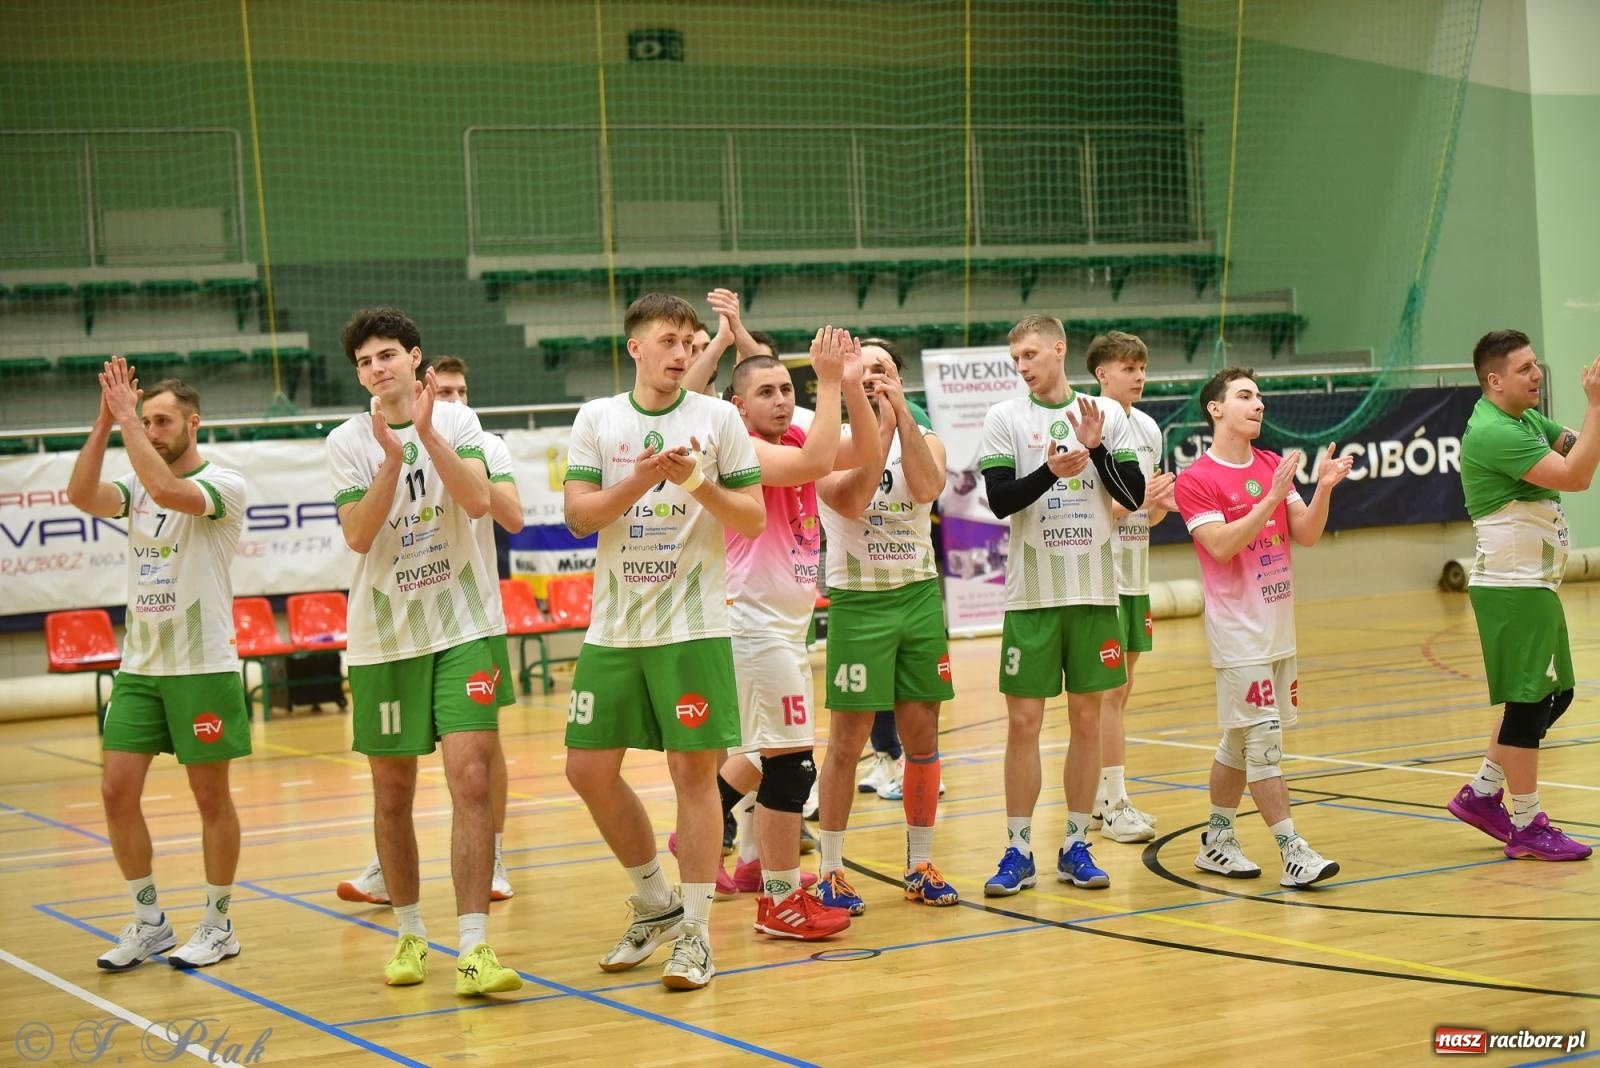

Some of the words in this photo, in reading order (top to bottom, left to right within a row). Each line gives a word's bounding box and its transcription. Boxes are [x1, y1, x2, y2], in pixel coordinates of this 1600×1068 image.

[938, 361, 1017, 381] PIVEXIN
[942, 380, 1018, 394] TECHNOLOGY
[405, 469, 426, 502] 11
[154, 513, 167, 538] 7
[389, 505, 445, 530] VISON
[1043, 527, 1093, 541] PIVEXIN
[1045, 538, 1093, 548] TECHNOLOGY
[868, 542, 916, 554] PIVEXIN
[396, 559, 450, 584] PIVEXIN
[399, 571, 452, 593] TECHNOLOGY
[1005, 647, 1020, 676] 3
[832, 663, 868, 693] 49
[1246, 679, 1276, 709] 42
[379, 701, 402, 735] 11
[781, 695, 807, 726] 15
